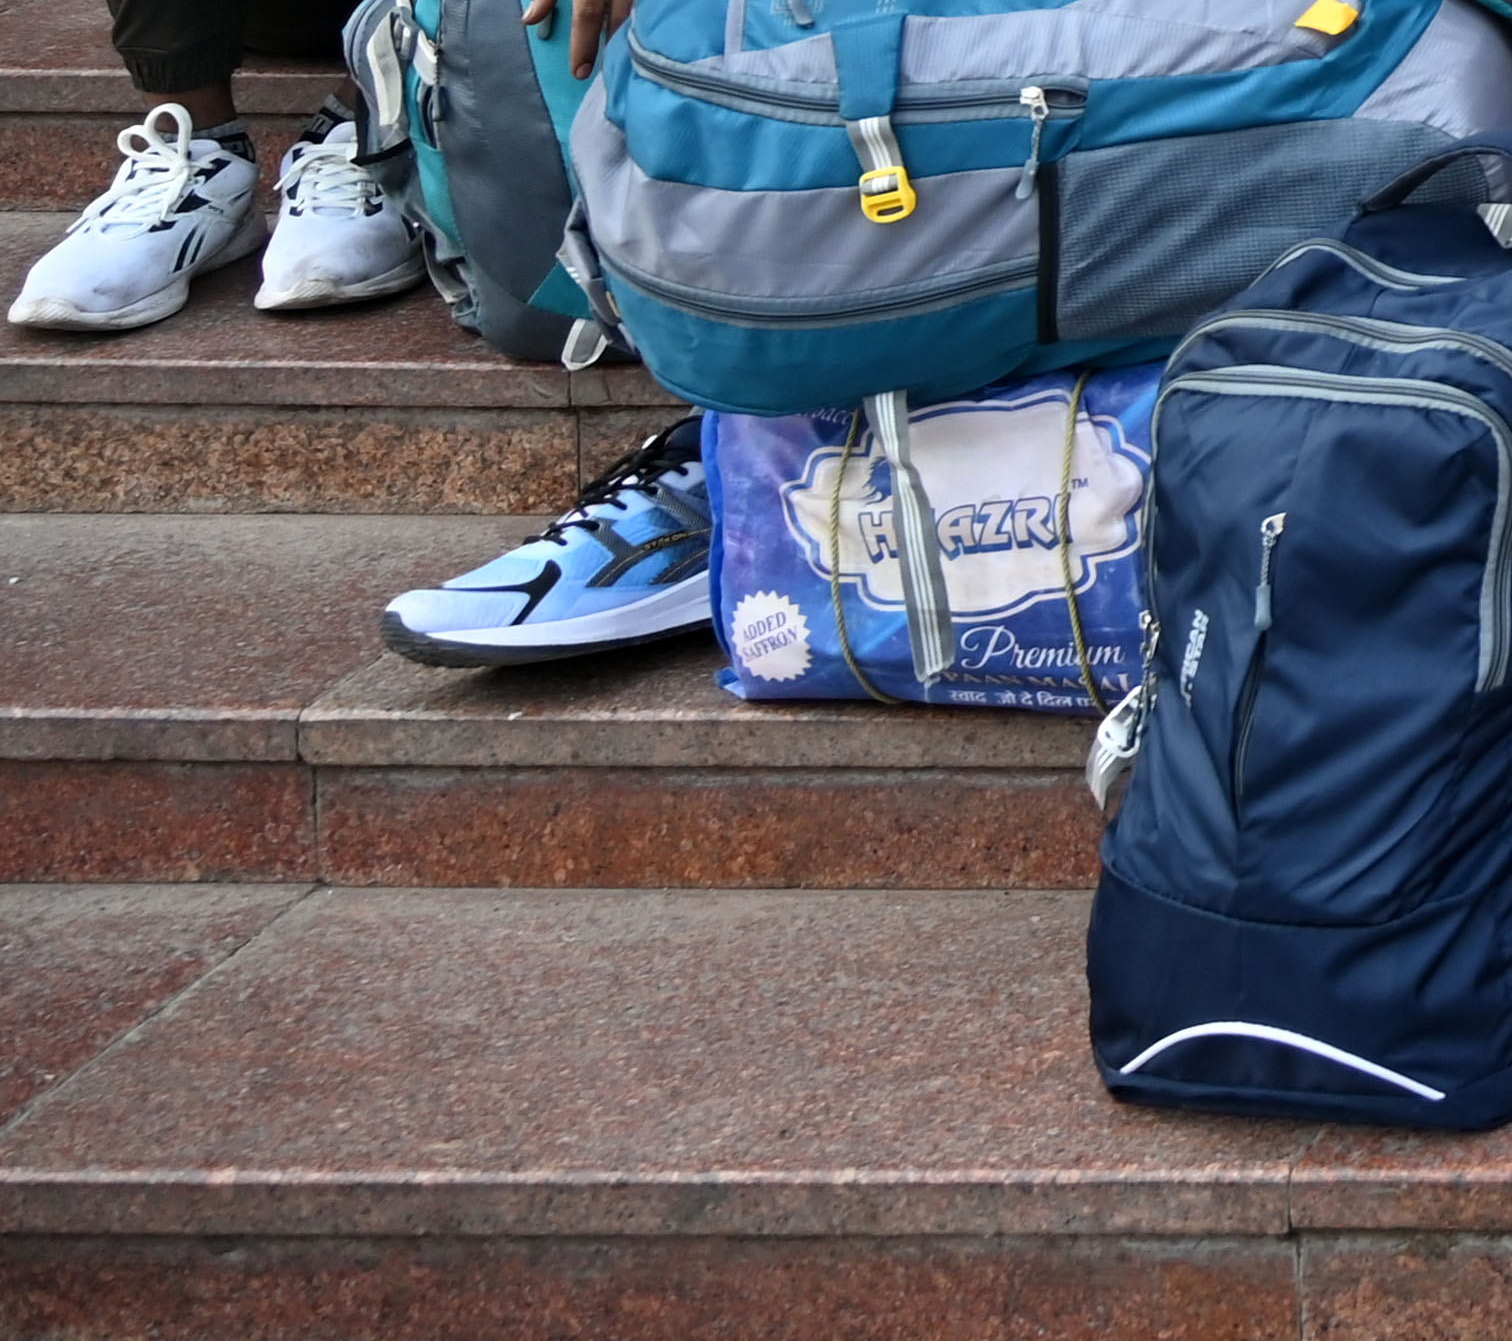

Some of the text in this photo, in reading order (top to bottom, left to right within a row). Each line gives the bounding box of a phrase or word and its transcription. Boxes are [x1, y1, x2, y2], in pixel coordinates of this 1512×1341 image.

[1071, 478, 1089, 490] TM
[858, 493, 1073, 565] HAZRI
[742, 626, 799, 663] SAFFRON
[743, 611, 787, 643] ADDED
[960, 624, 1125, 670] Premium
